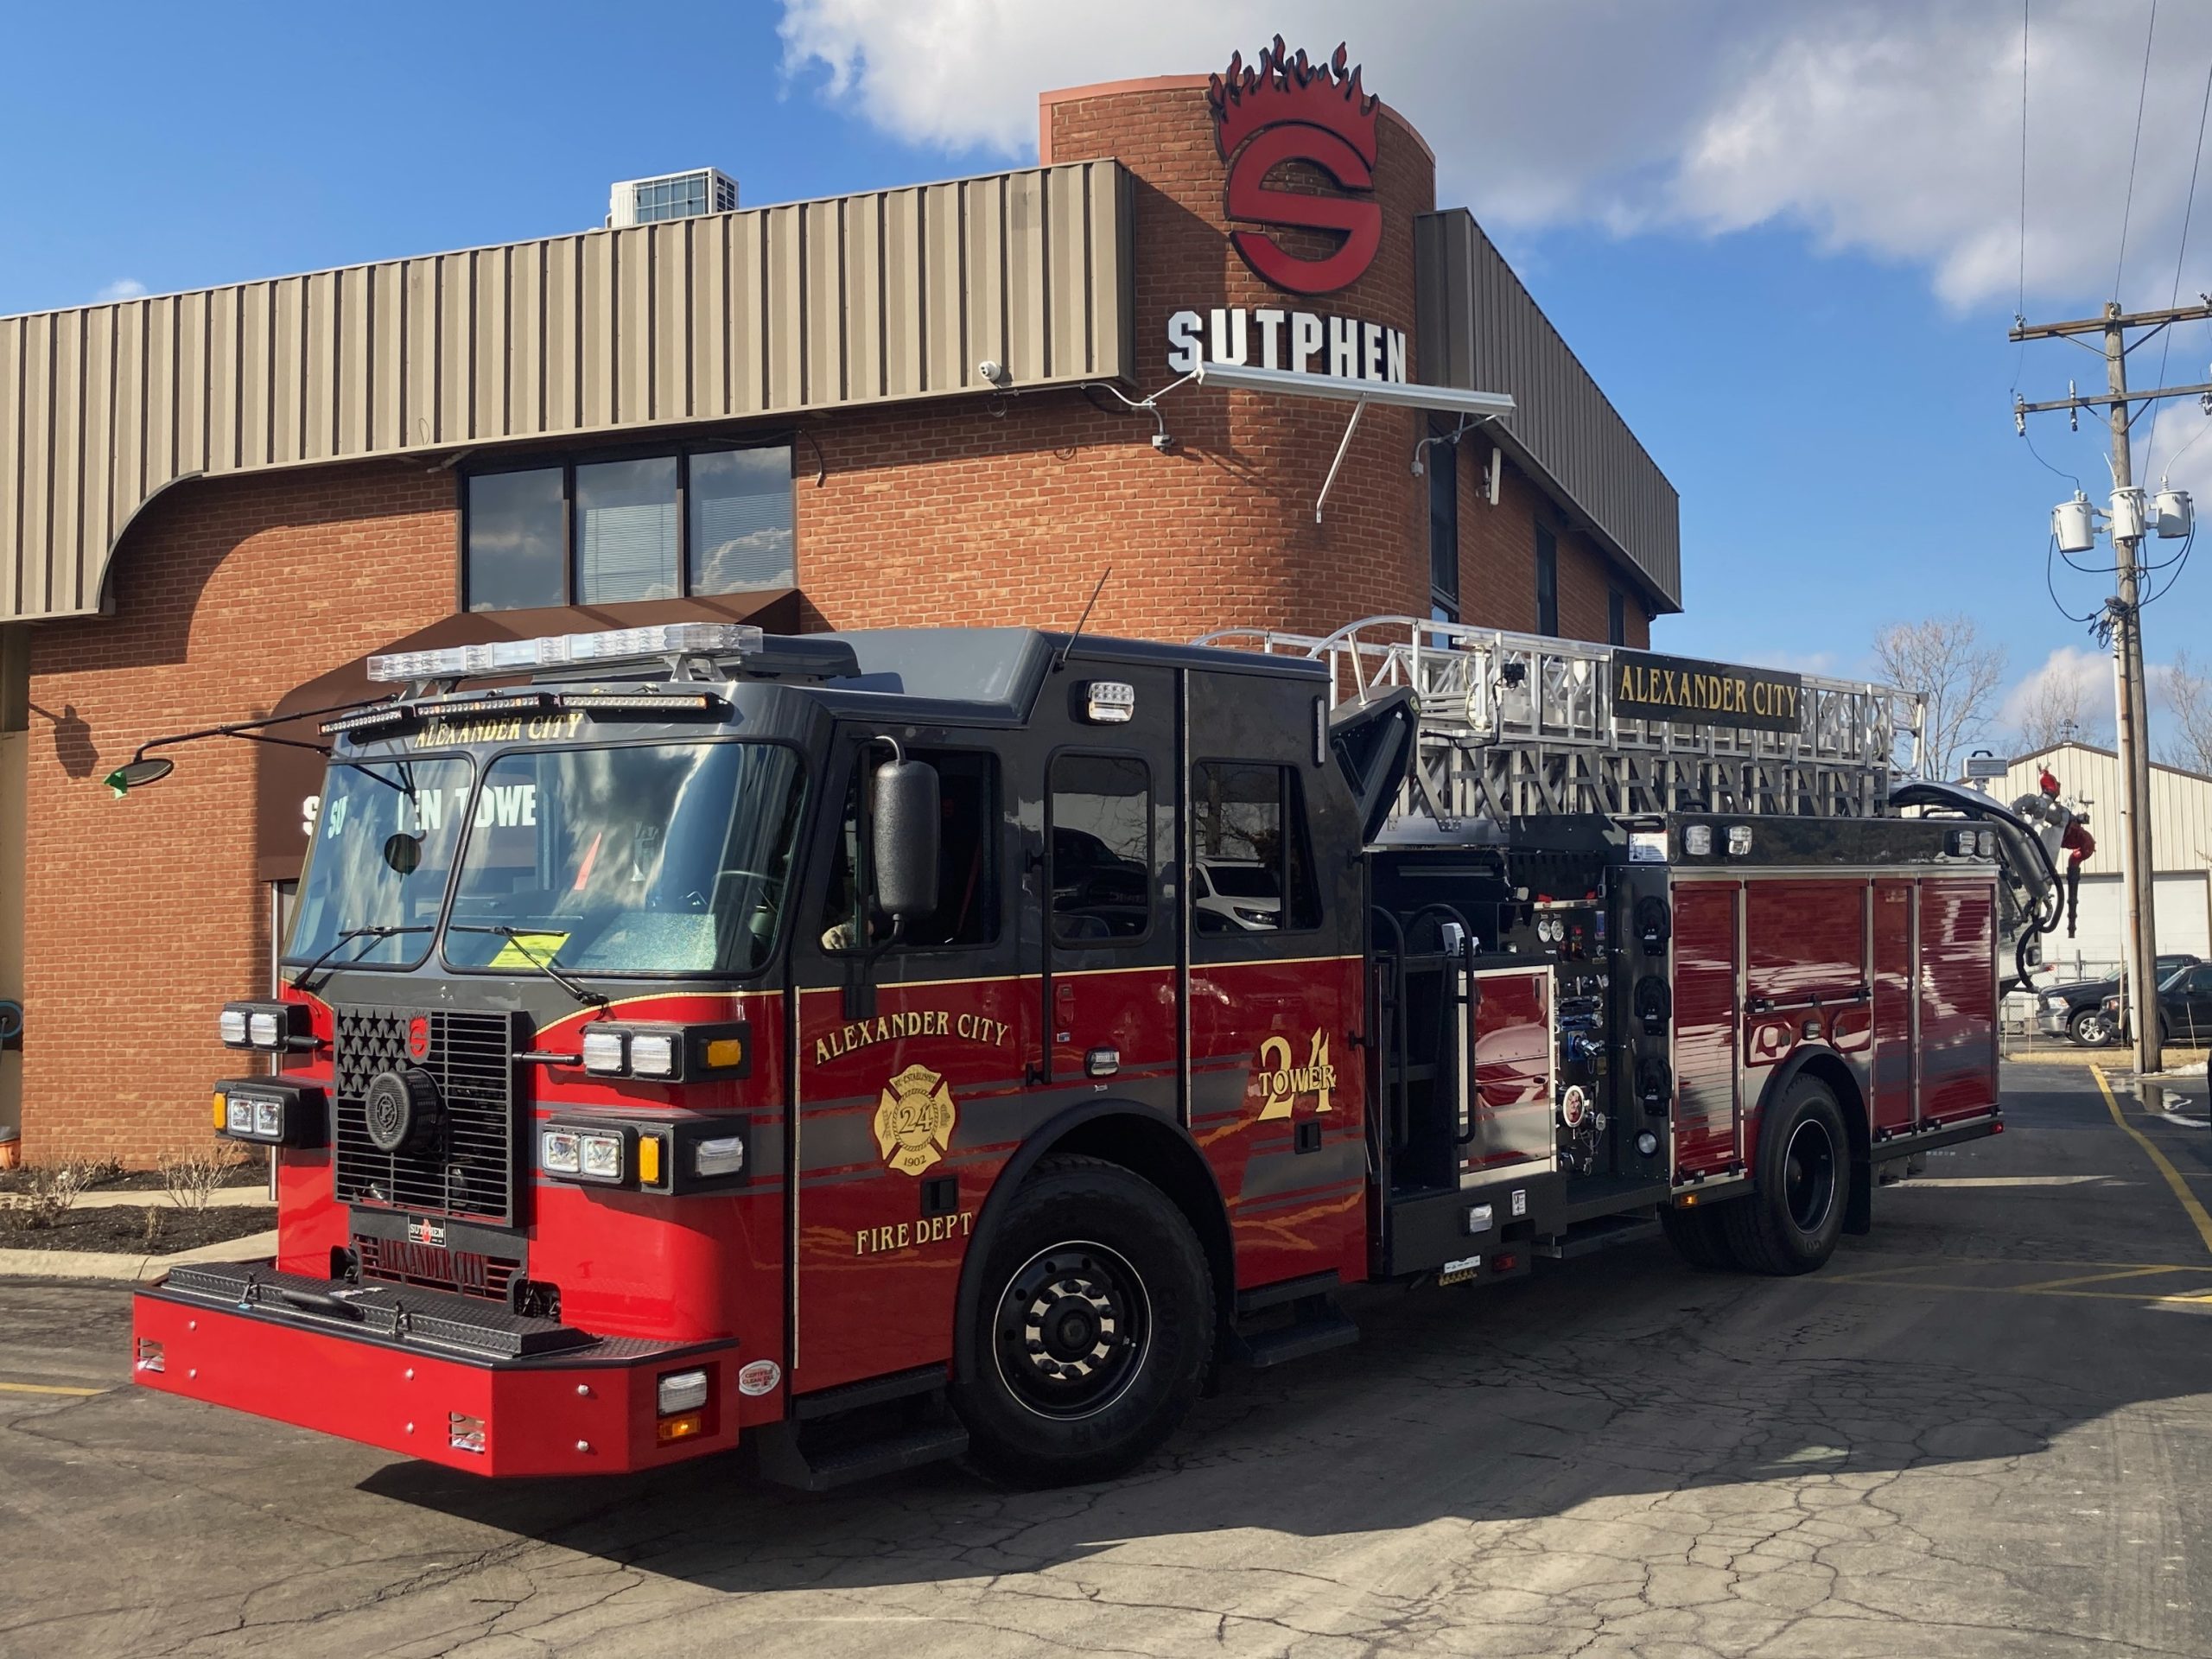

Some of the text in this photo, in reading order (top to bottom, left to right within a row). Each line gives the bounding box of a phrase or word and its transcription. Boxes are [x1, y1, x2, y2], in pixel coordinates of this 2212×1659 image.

[1167, 308, 1407, 384] SUTPHEN
[1618, 664, 1798, 718] ALEXANDER CITY
[414, 713, 584, 748] ALEXANDER CITY
[816, 1011, 1009, 1065] ALEXANDER CITY
[1256, 1026, 1333, 1122] 24
[1258, 1064, 1338, 1097] TOWER
[899, 1103, 933, 1134] 24
[904, 1155, 926, 1167] 1902
[410, 1224, 444, 1238] SUTPHEN
[855, 1211, 973, 1255] FIRE DEPT
